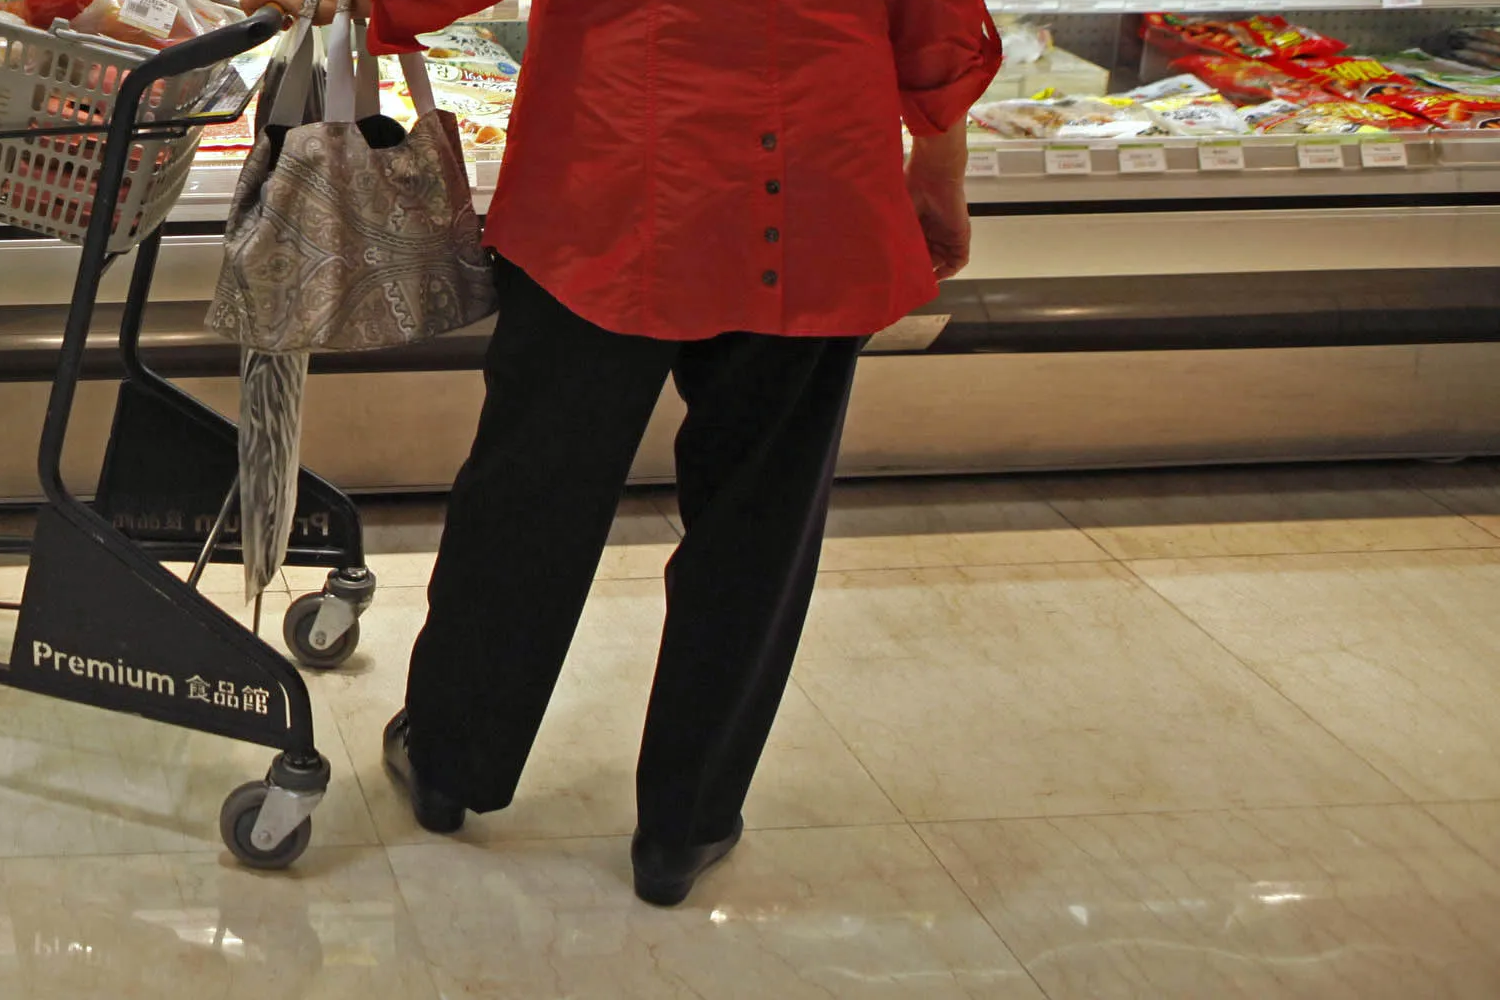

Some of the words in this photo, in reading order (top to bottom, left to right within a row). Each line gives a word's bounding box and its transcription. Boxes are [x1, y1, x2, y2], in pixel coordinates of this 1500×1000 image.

[32, 640, 175, 696] Premium
[185, 674, 270, 715] 食品館
